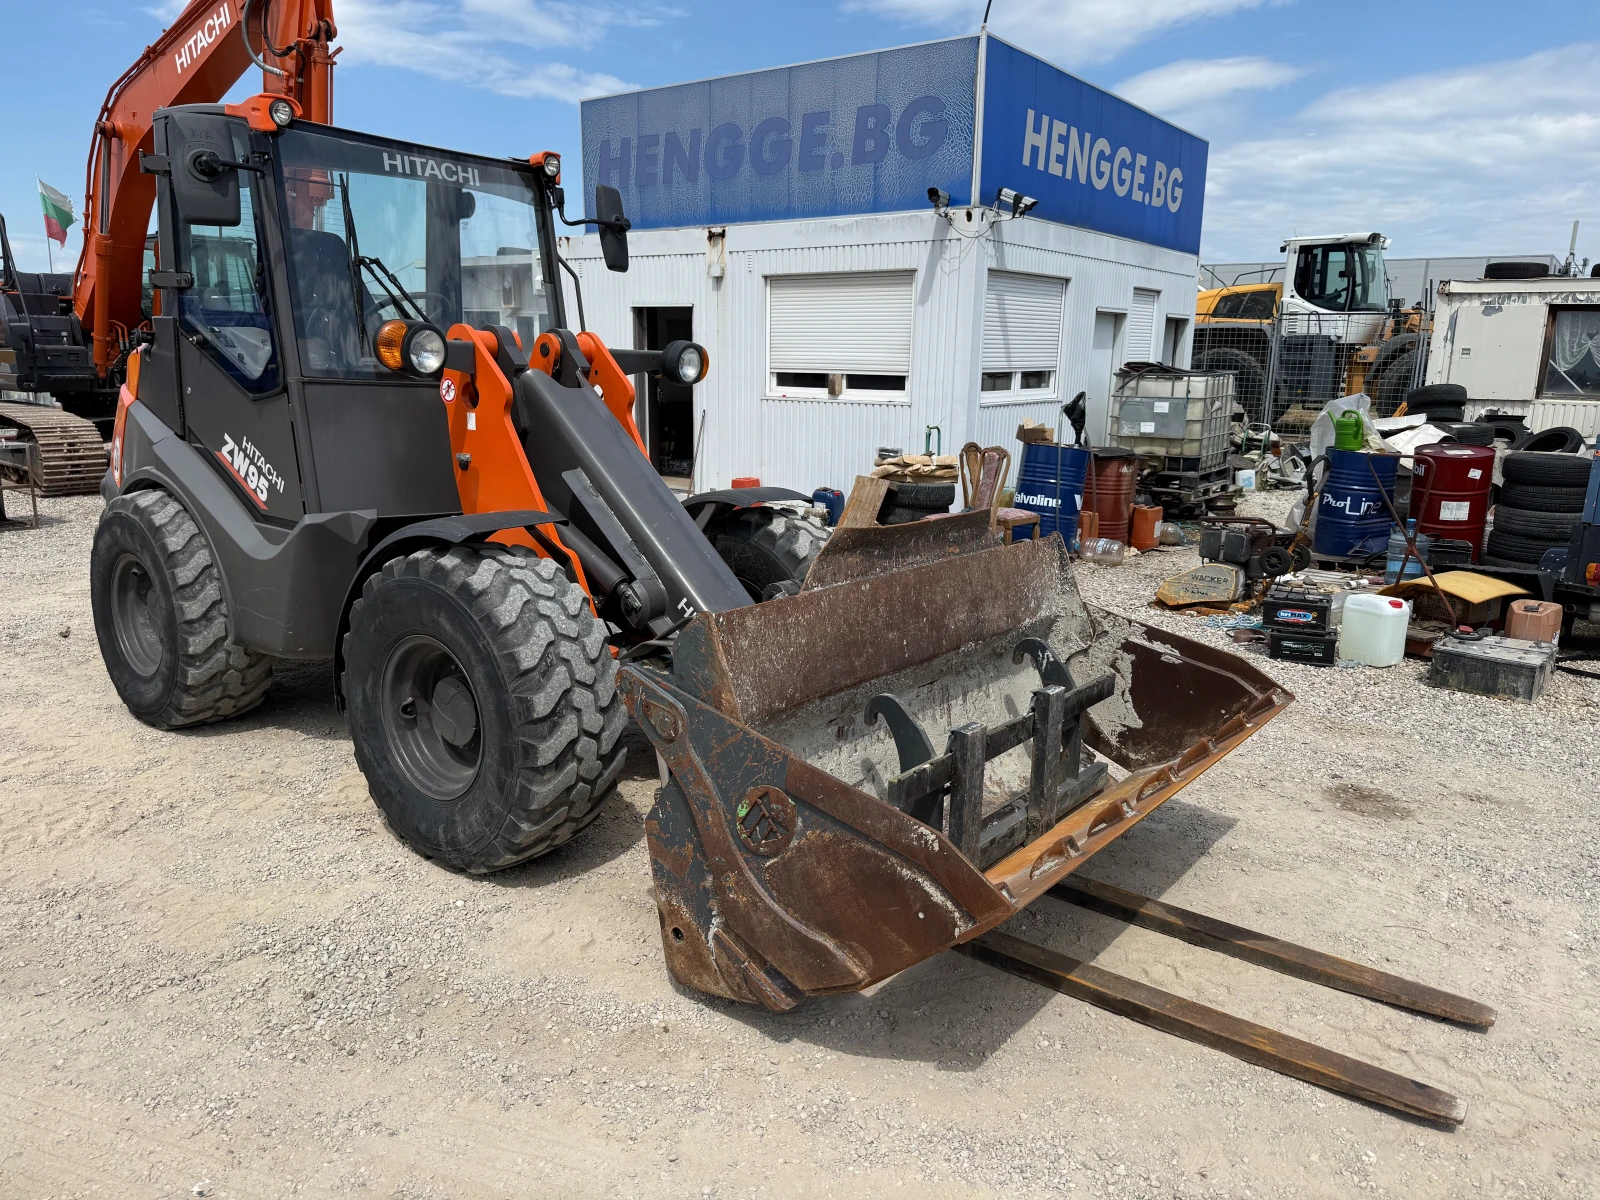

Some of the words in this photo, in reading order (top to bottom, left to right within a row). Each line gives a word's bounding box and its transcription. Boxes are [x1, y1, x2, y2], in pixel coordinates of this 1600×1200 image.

[174, 2, 231, 75] HITACHI
[382, 152, 481, 187] HITACHI
[599, 95, 949, 189] HENGGE.BG
[1022, 108, 1184, 214] HENGGE.BG
[221, 432, 269, 502] ZW95
[242, 435, 285, 494] HITACHI
[1413, 462, 1427, 477] bil
[1191, 573, 1229, 585] WACKER
